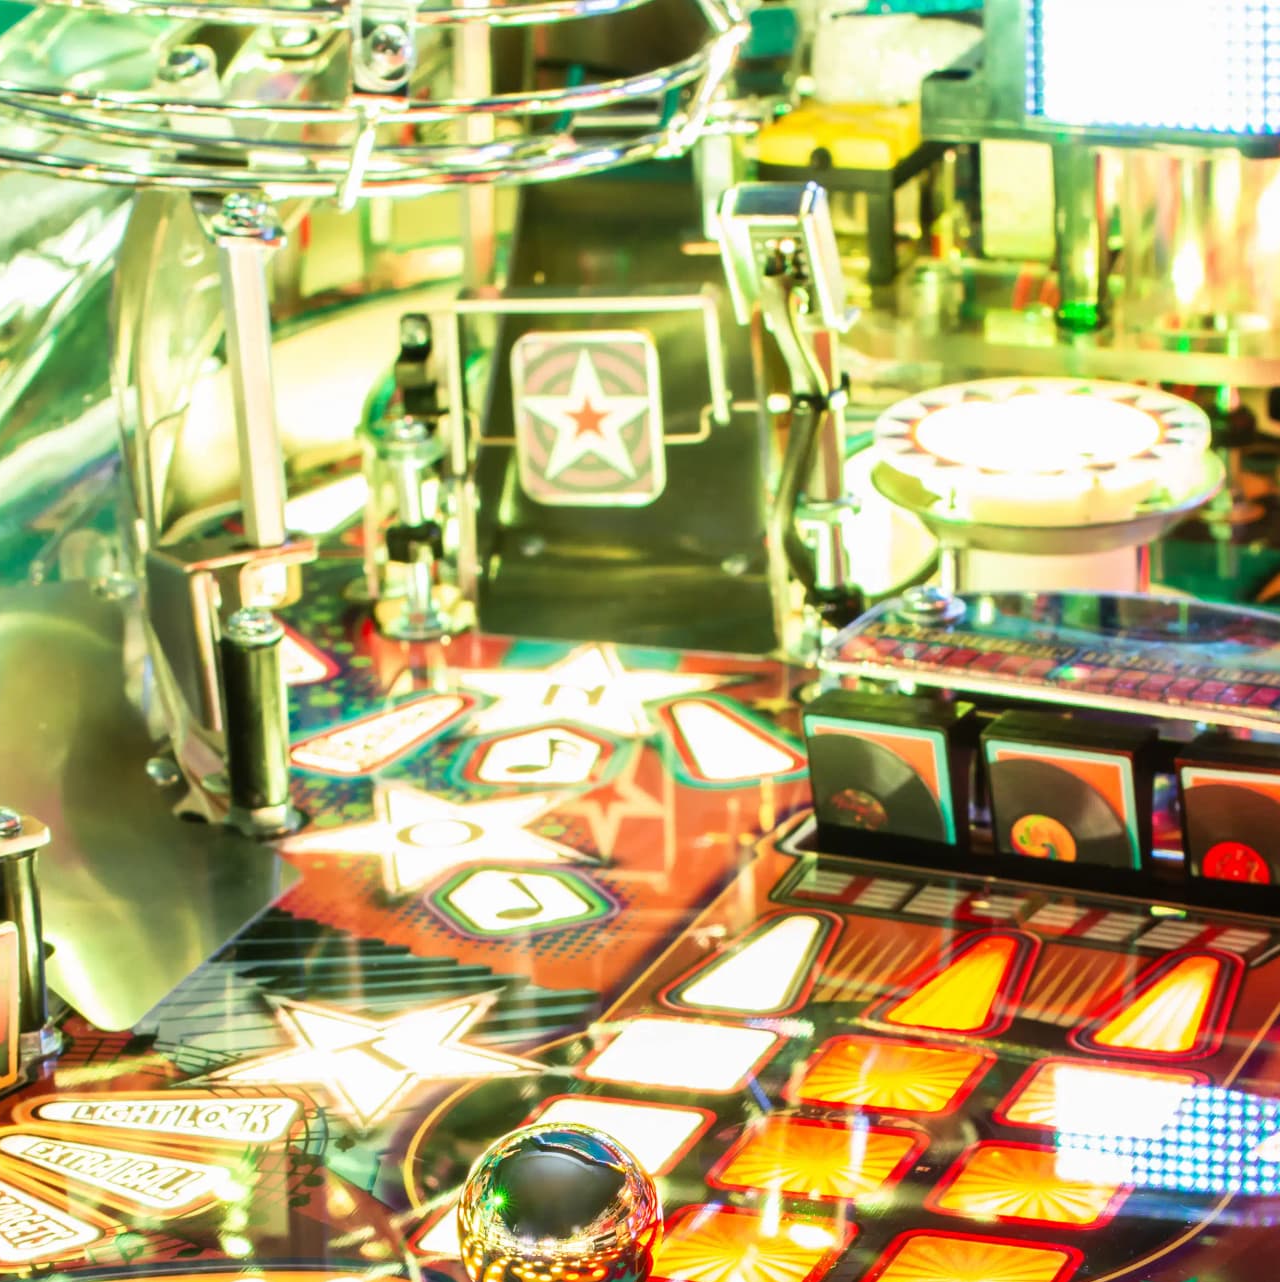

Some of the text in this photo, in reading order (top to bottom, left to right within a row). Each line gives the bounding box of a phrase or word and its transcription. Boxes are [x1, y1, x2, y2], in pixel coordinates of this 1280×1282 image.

[396, 818, 485, 850] O
[330, 1036, 418, 1071] T
[71, 1102, 284, 1135] LIGHT LOCK
[19, 1141, 206, 1202] EXTRA BALL
